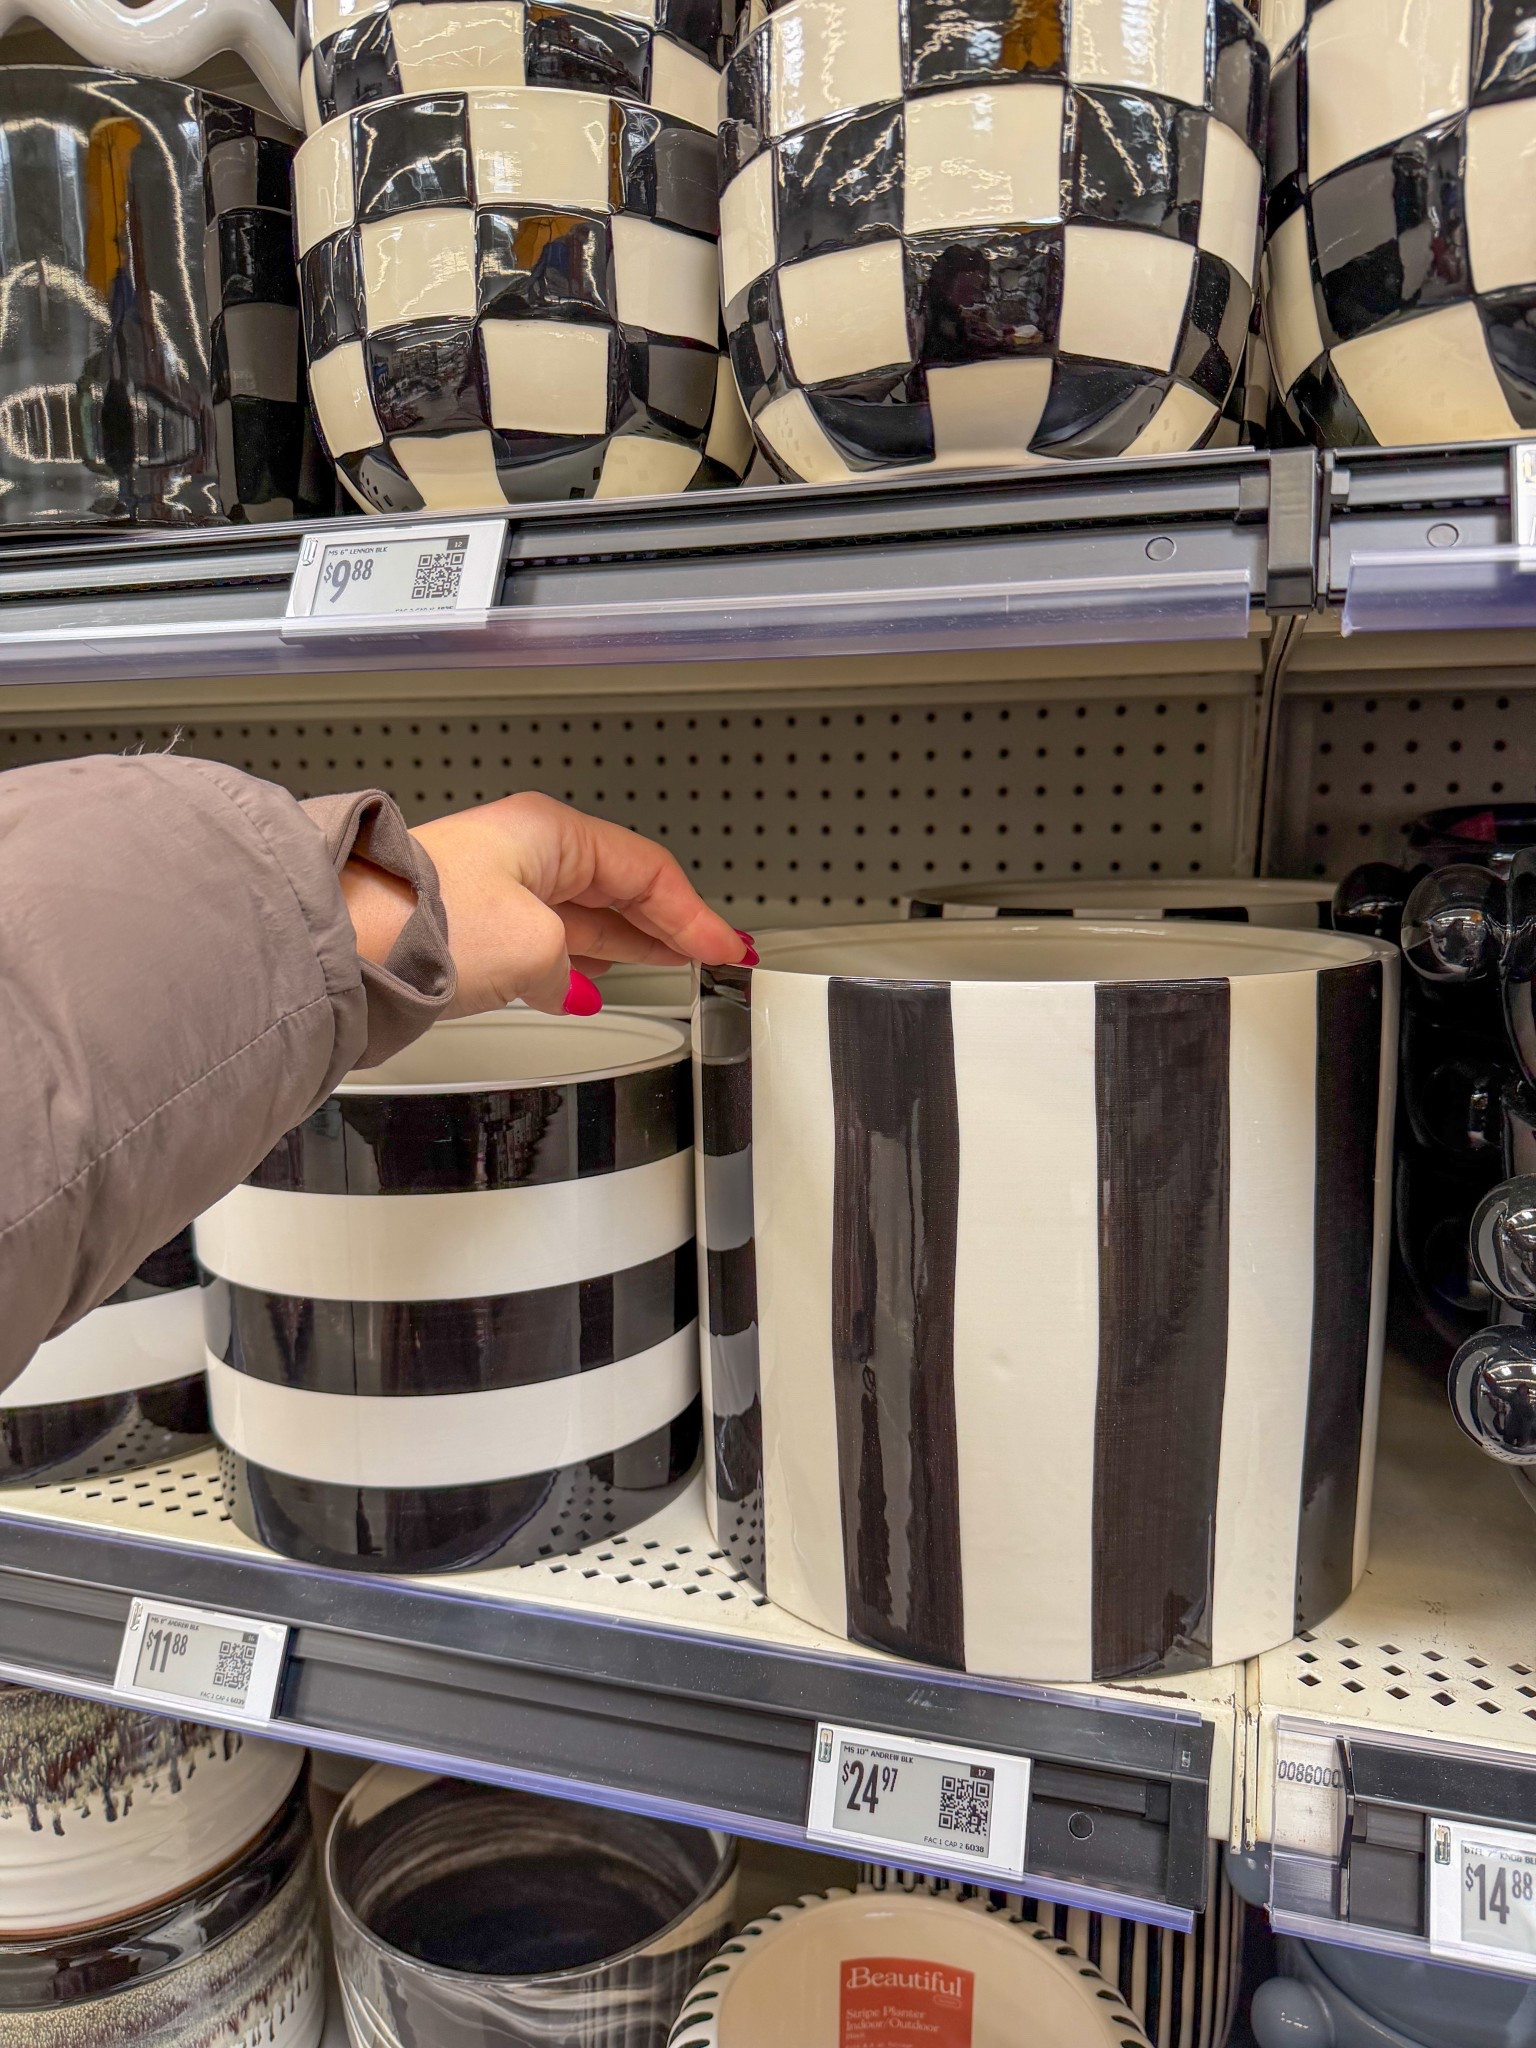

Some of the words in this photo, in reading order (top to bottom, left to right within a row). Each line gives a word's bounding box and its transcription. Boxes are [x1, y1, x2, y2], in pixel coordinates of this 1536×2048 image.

[870, 1750, 900, 1762] ANDREW
[900, 1756, 915, 1764] BLK
[977, 1768, 987, 1777] 17
[923, 1836, 938, 1845] FAC
[944, 1839, 958, 1848] CAP
[965, 1843, 985, 1853] 6038
[846, 1966, 963, 1998] Beautiful
[846, 2007, 880, 2020] Stripe
[882, 2005, 926, 2019] Planter
[846, 2016, 940, 2033] Indoor/Outdoor
